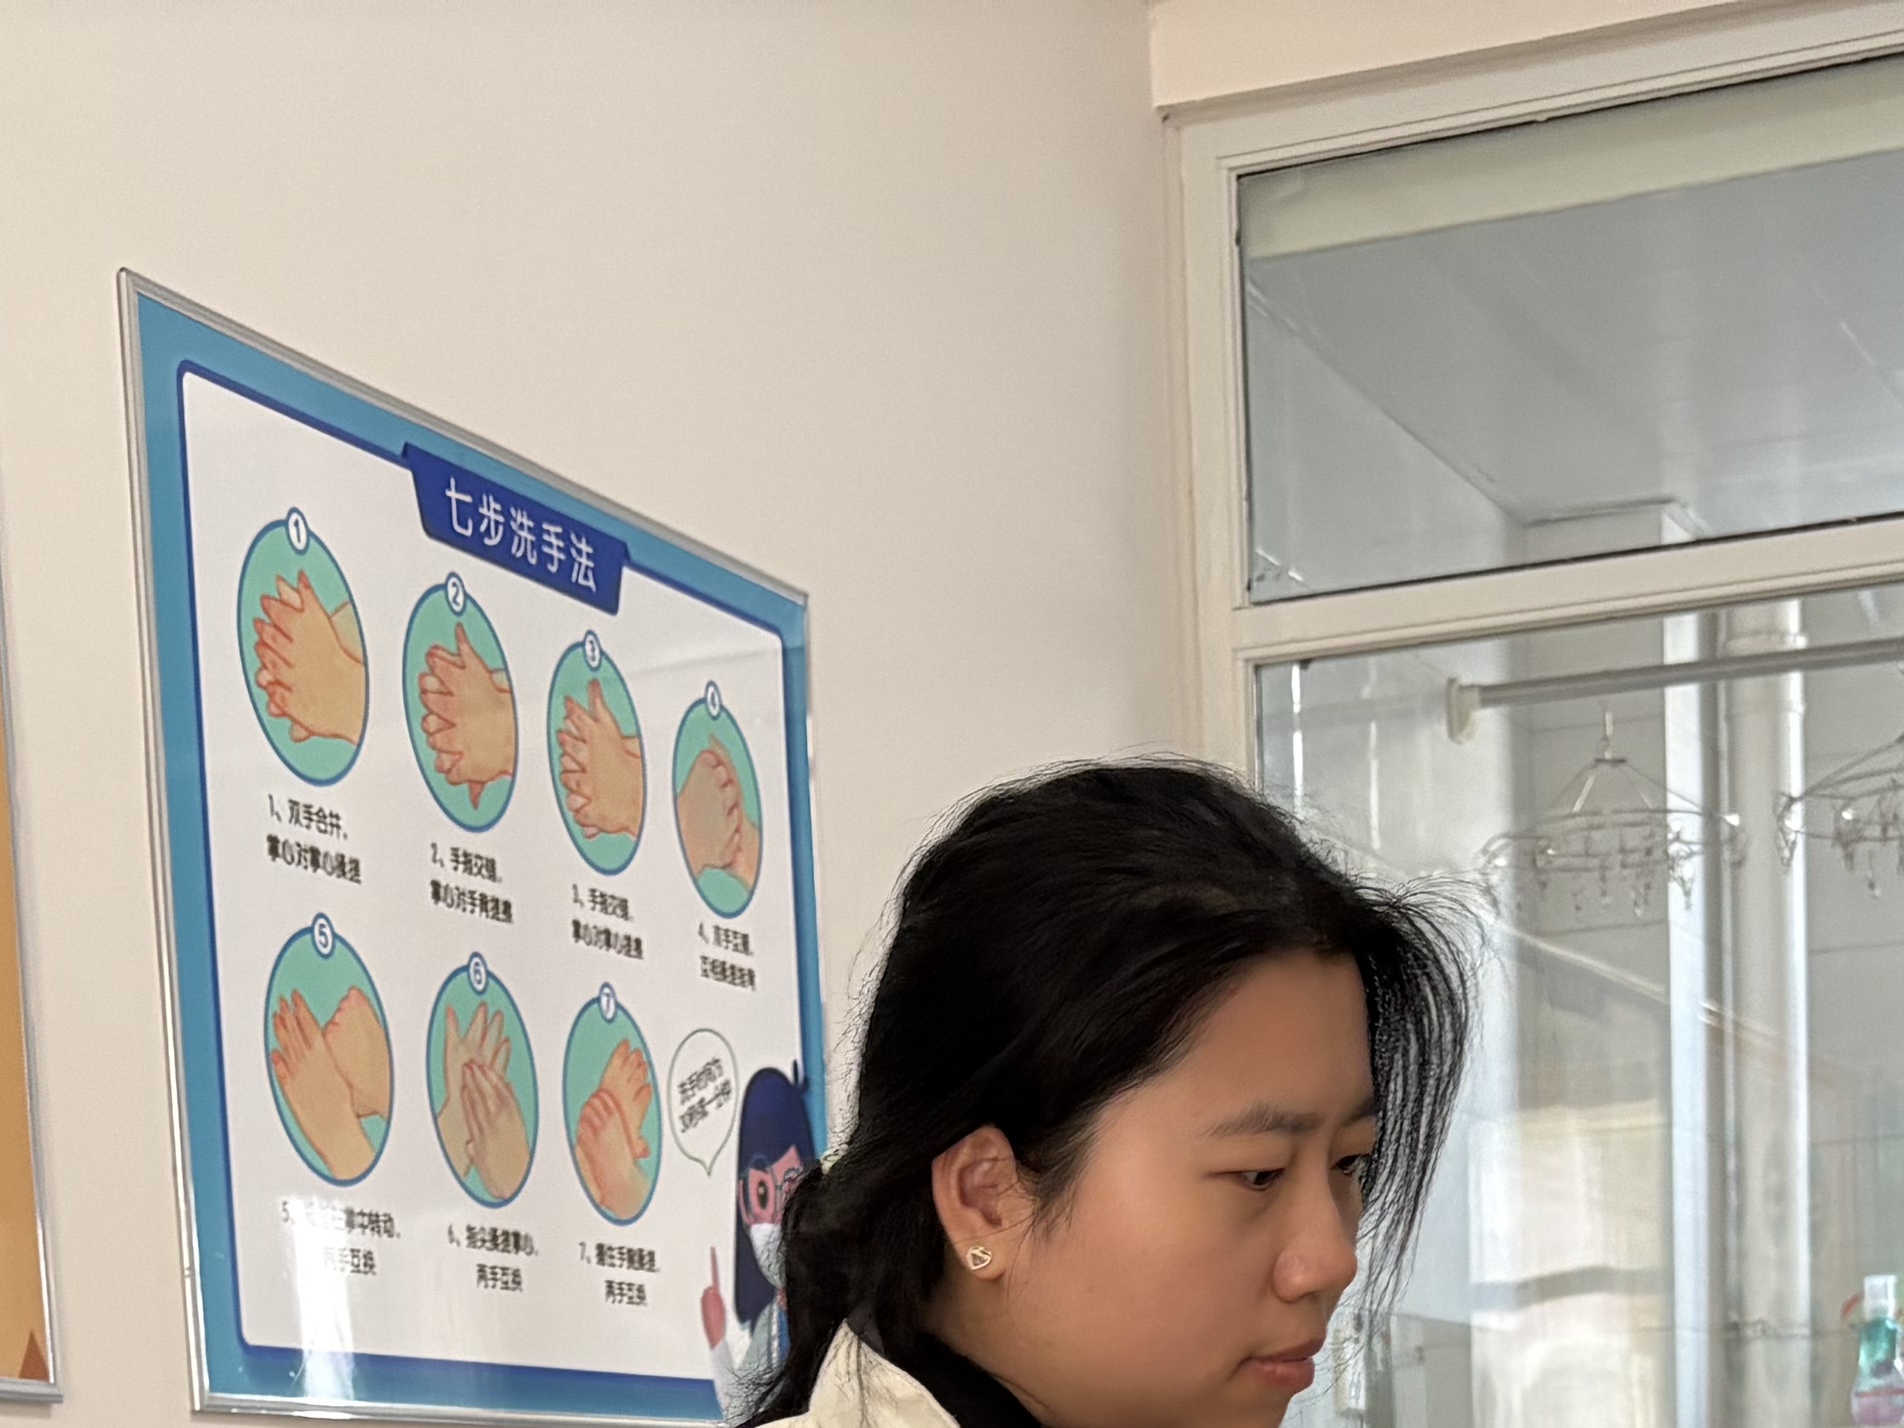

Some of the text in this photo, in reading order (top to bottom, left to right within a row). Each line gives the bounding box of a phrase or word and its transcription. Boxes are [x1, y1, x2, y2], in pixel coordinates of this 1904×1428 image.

[445, 476, 597, 592] 七步洗手法
